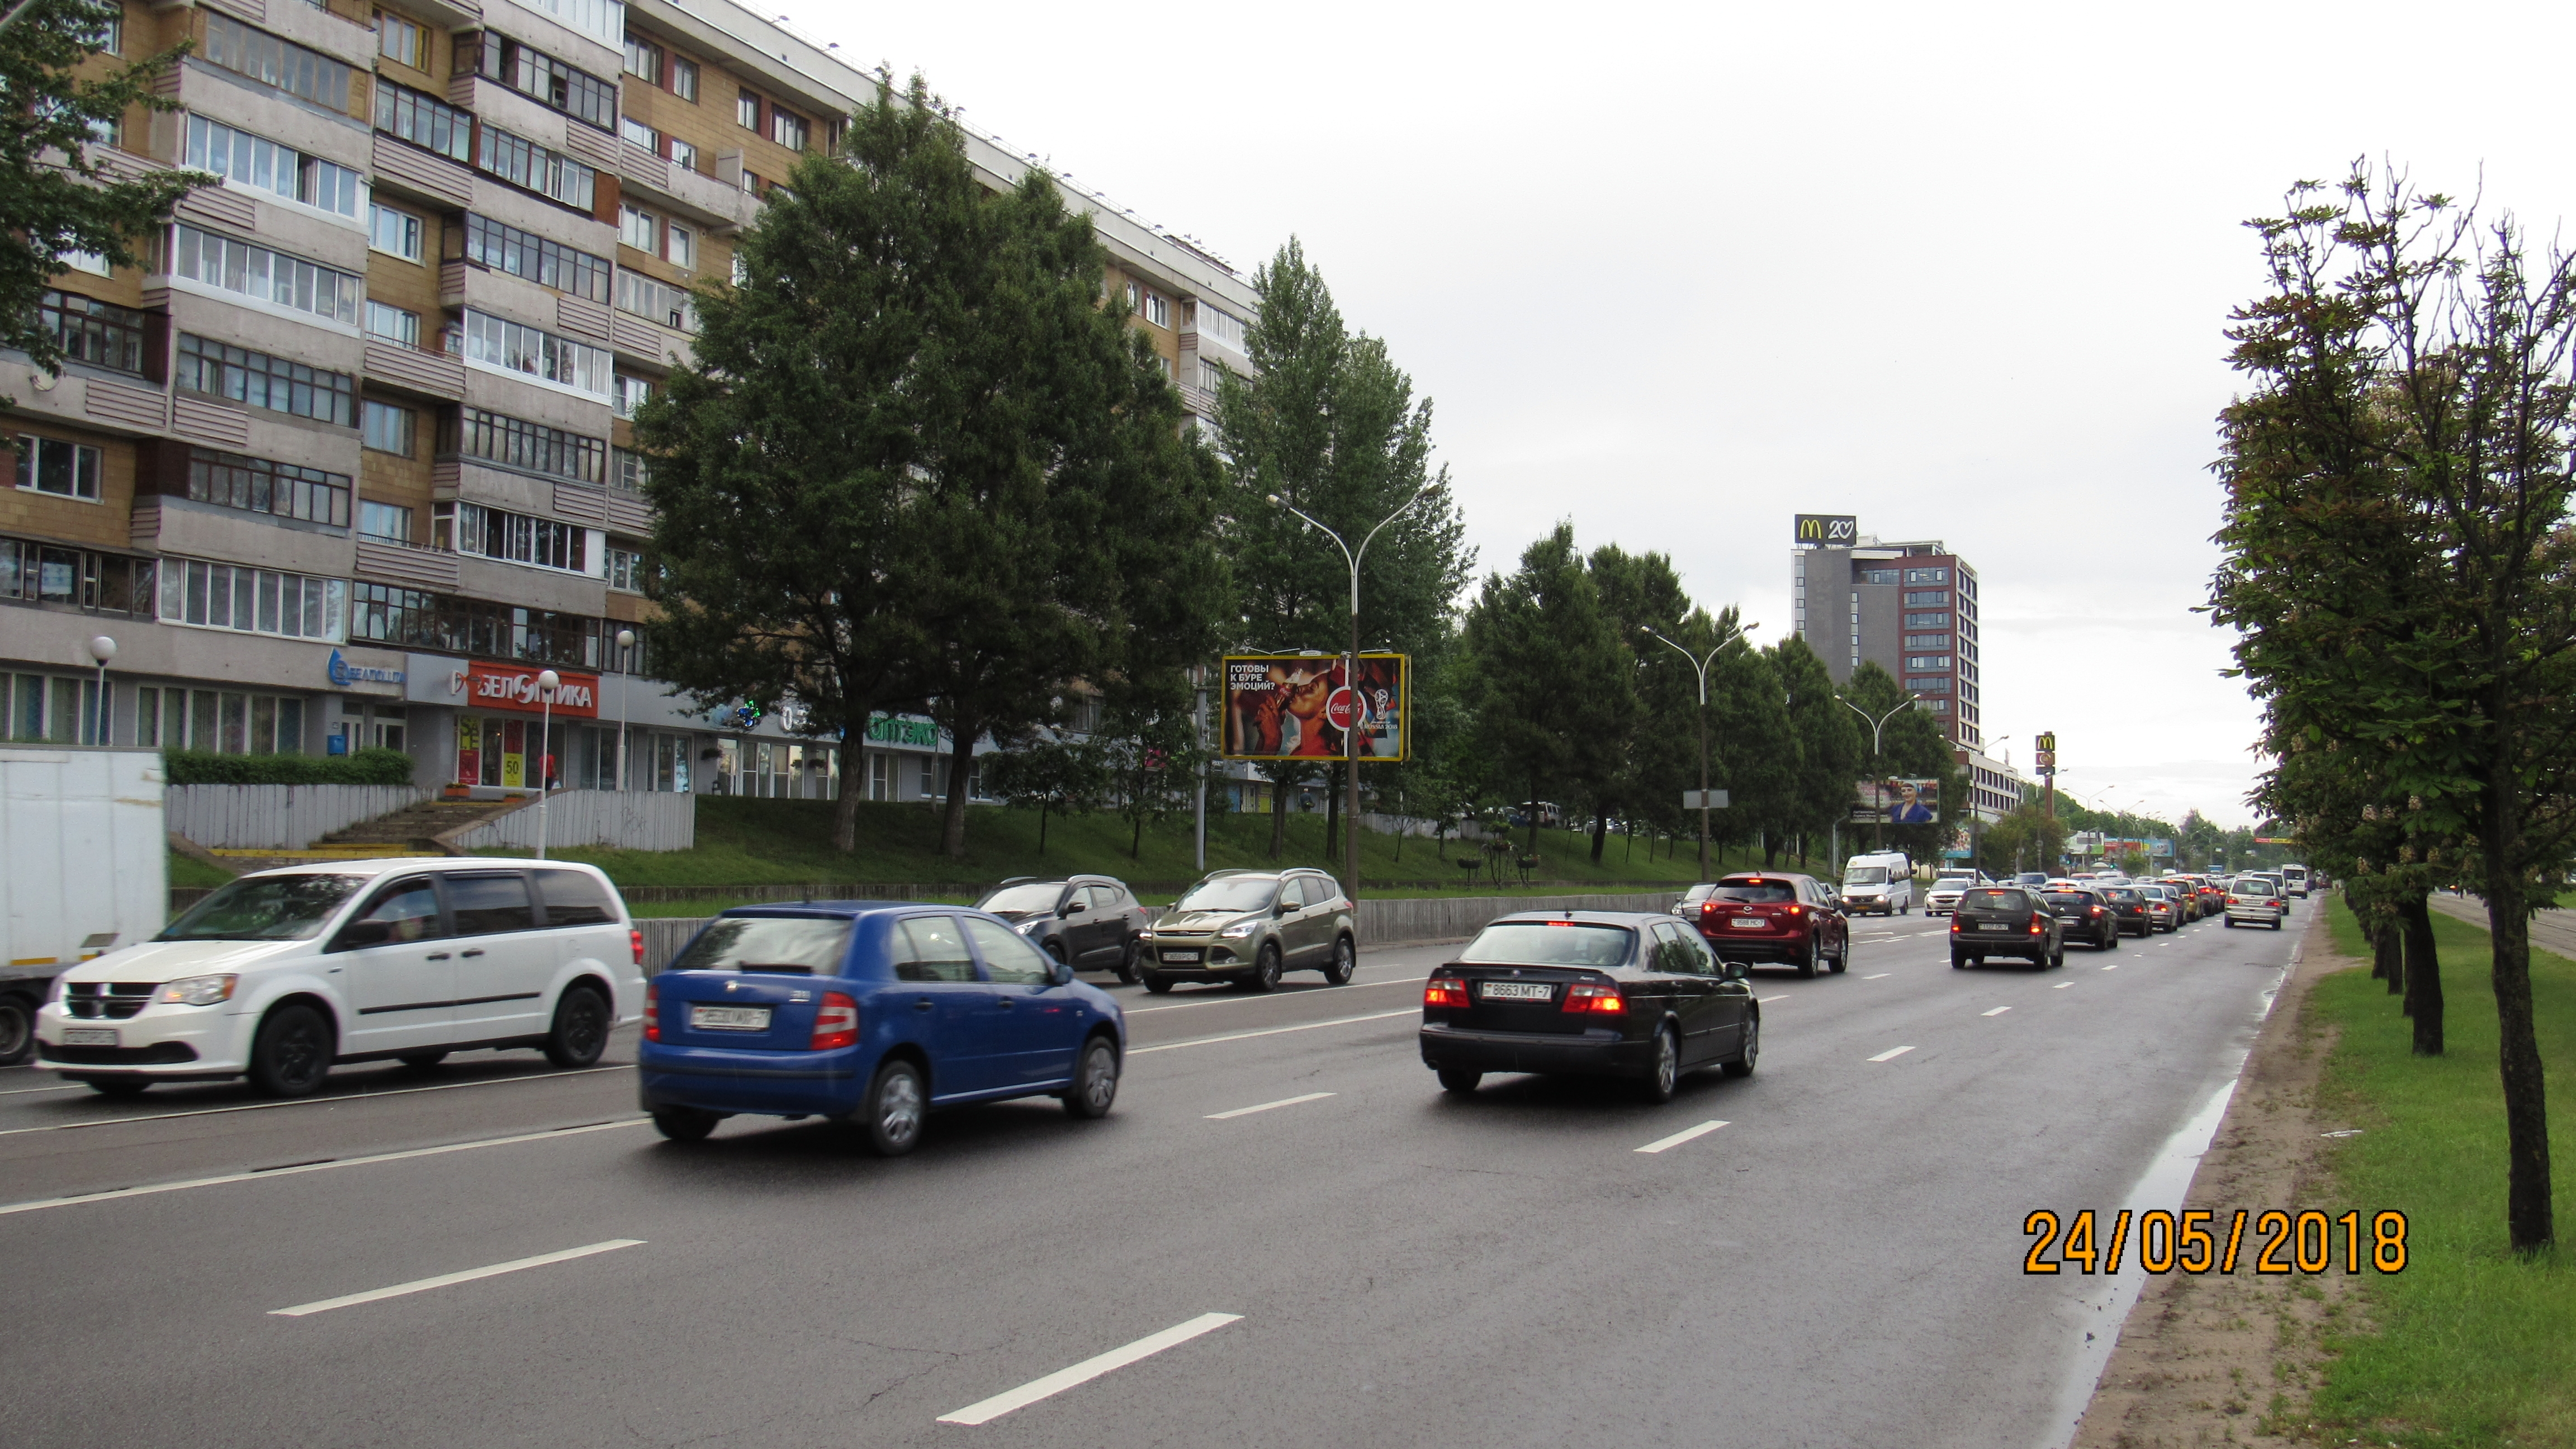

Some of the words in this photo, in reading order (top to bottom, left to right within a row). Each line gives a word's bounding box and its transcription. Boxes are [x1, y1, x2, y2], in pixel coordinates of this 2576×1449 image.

[1230, 680, 1275, 691] ЭМОЦИЙ?
[506, 760, 519, 774] 50
[1520, 985, 1550, 998] MT-7
